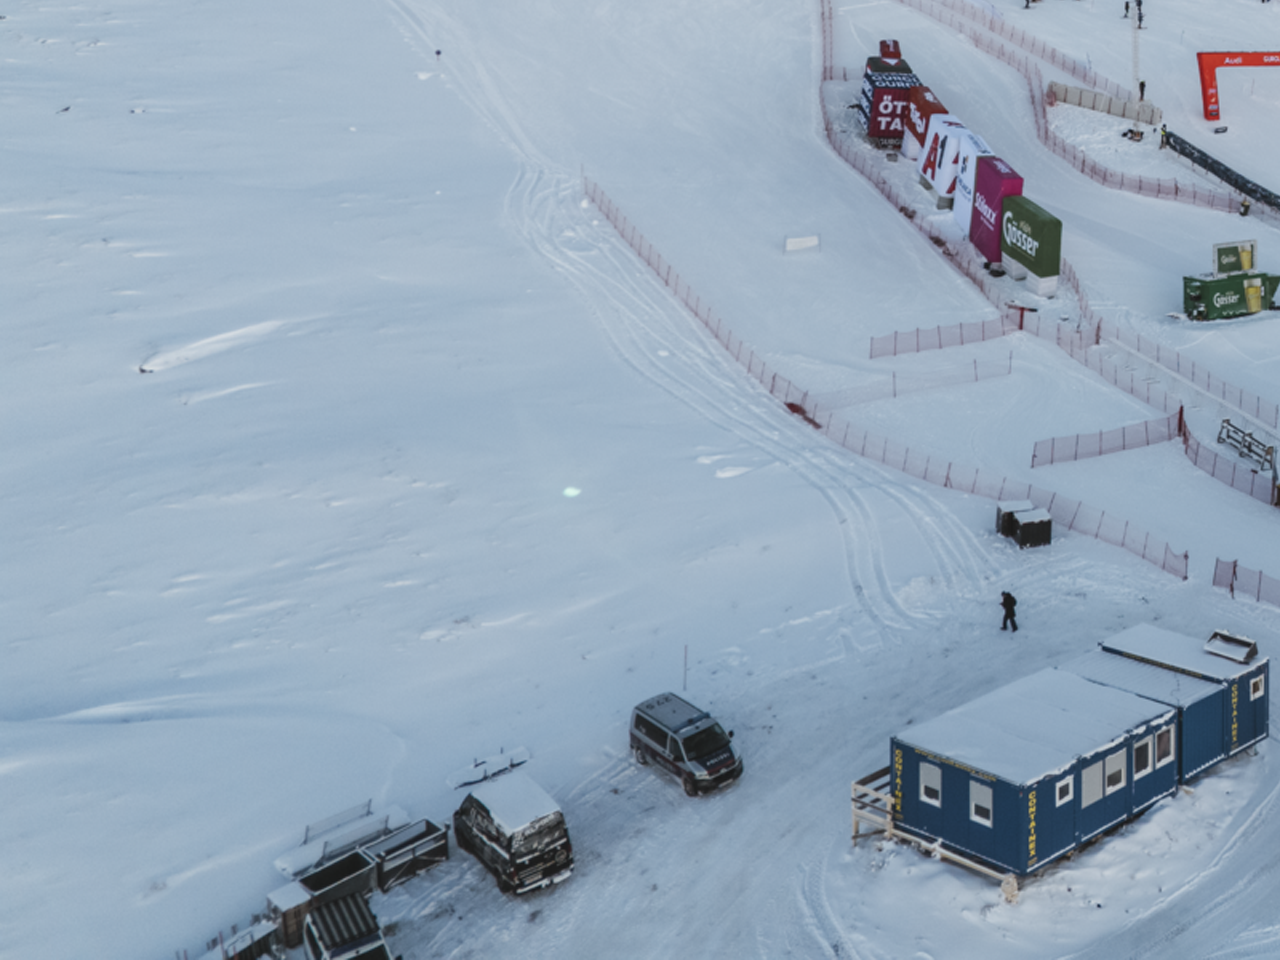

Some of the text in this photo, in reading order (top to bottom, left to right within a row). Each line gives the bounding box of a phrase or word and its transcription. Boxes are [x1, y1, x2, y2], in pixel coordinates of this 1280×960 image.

[921, 132, 948, 181] A1
[1003, 211, 1039, 256] Gösser
[1028, 791, 1037, 858] CONTAINEX
